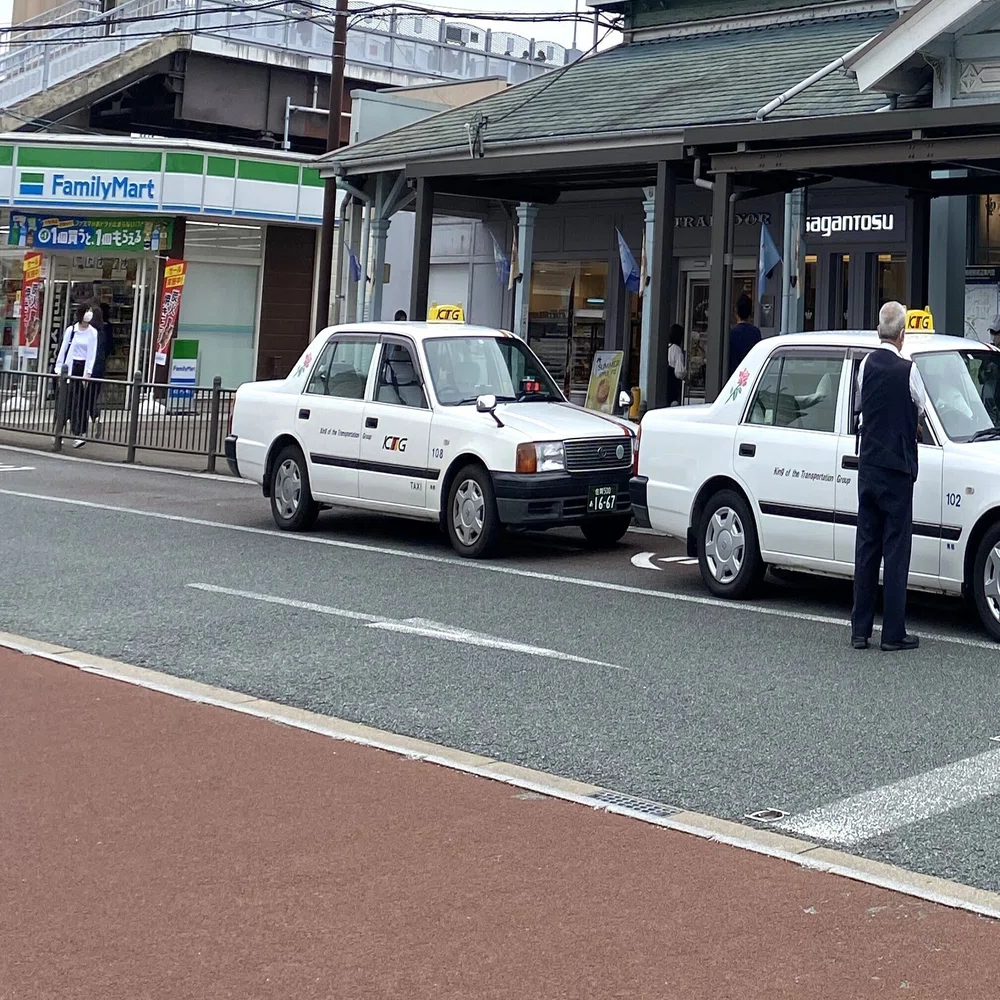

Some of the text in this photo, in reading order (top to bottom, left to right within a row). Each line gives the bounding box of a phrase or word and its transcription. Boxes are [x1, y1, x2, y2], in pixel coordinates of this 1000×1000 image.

[52, 174, 155, 200] FamilyMart
[432, 448, 444, 459] 108
[773, 467, 851, 486] King of the Transportation Group
[410, 481, 422, 491] TAXI
[946, 493, 961, 507] 102
